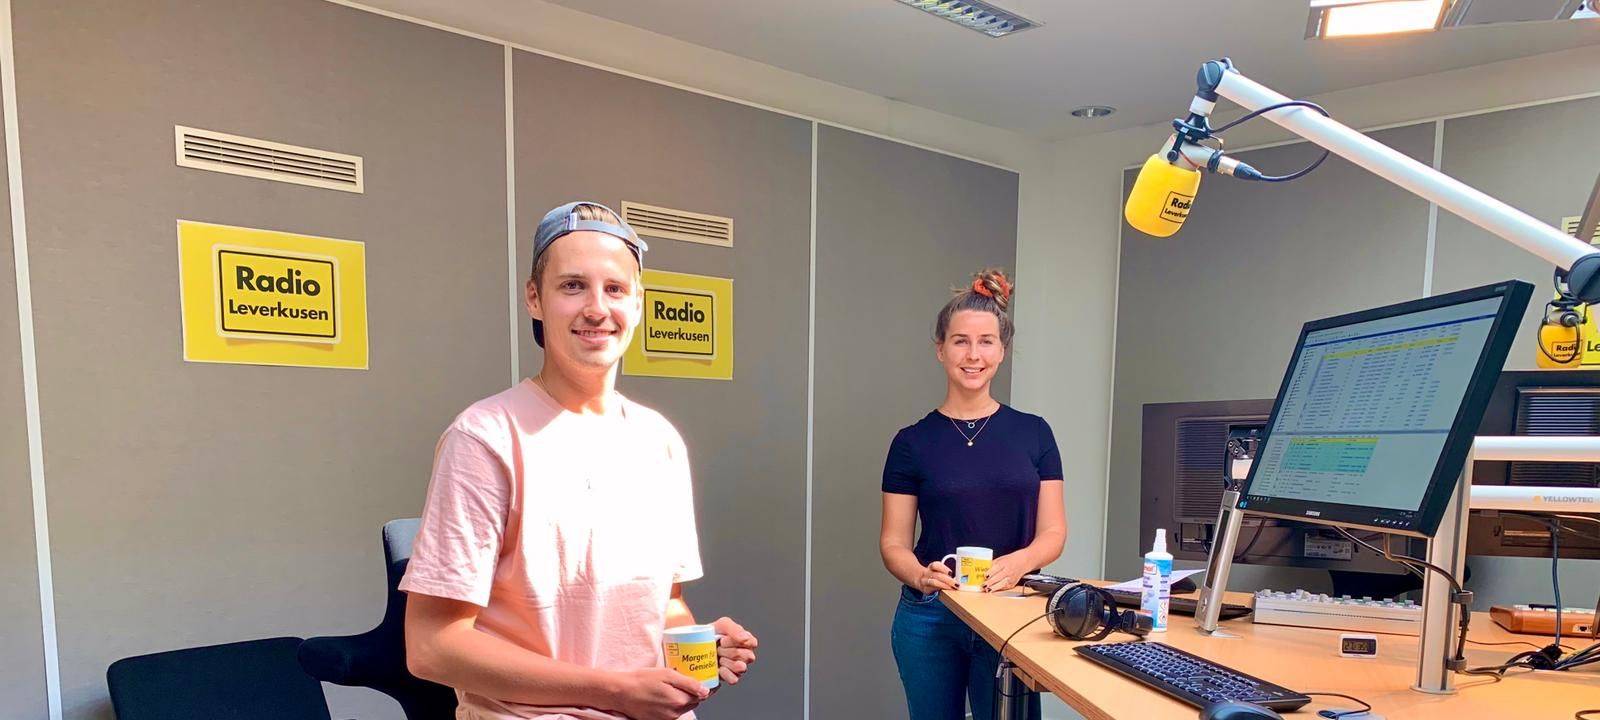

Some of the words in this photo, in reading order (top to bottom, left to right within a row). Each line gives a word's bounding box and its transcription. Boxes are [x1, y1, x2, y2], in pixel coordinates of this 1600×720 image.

[236, 265, 321, 296] Radio
[228, 298, 329, 321] Leverkusen
[654, 300, 705, 323] Radio
[649, 326, 710, 342] Leverkusen
[1543, 495, 1594, 504] YELLOWTEC
[682, 653, 709, 662] Morgen
